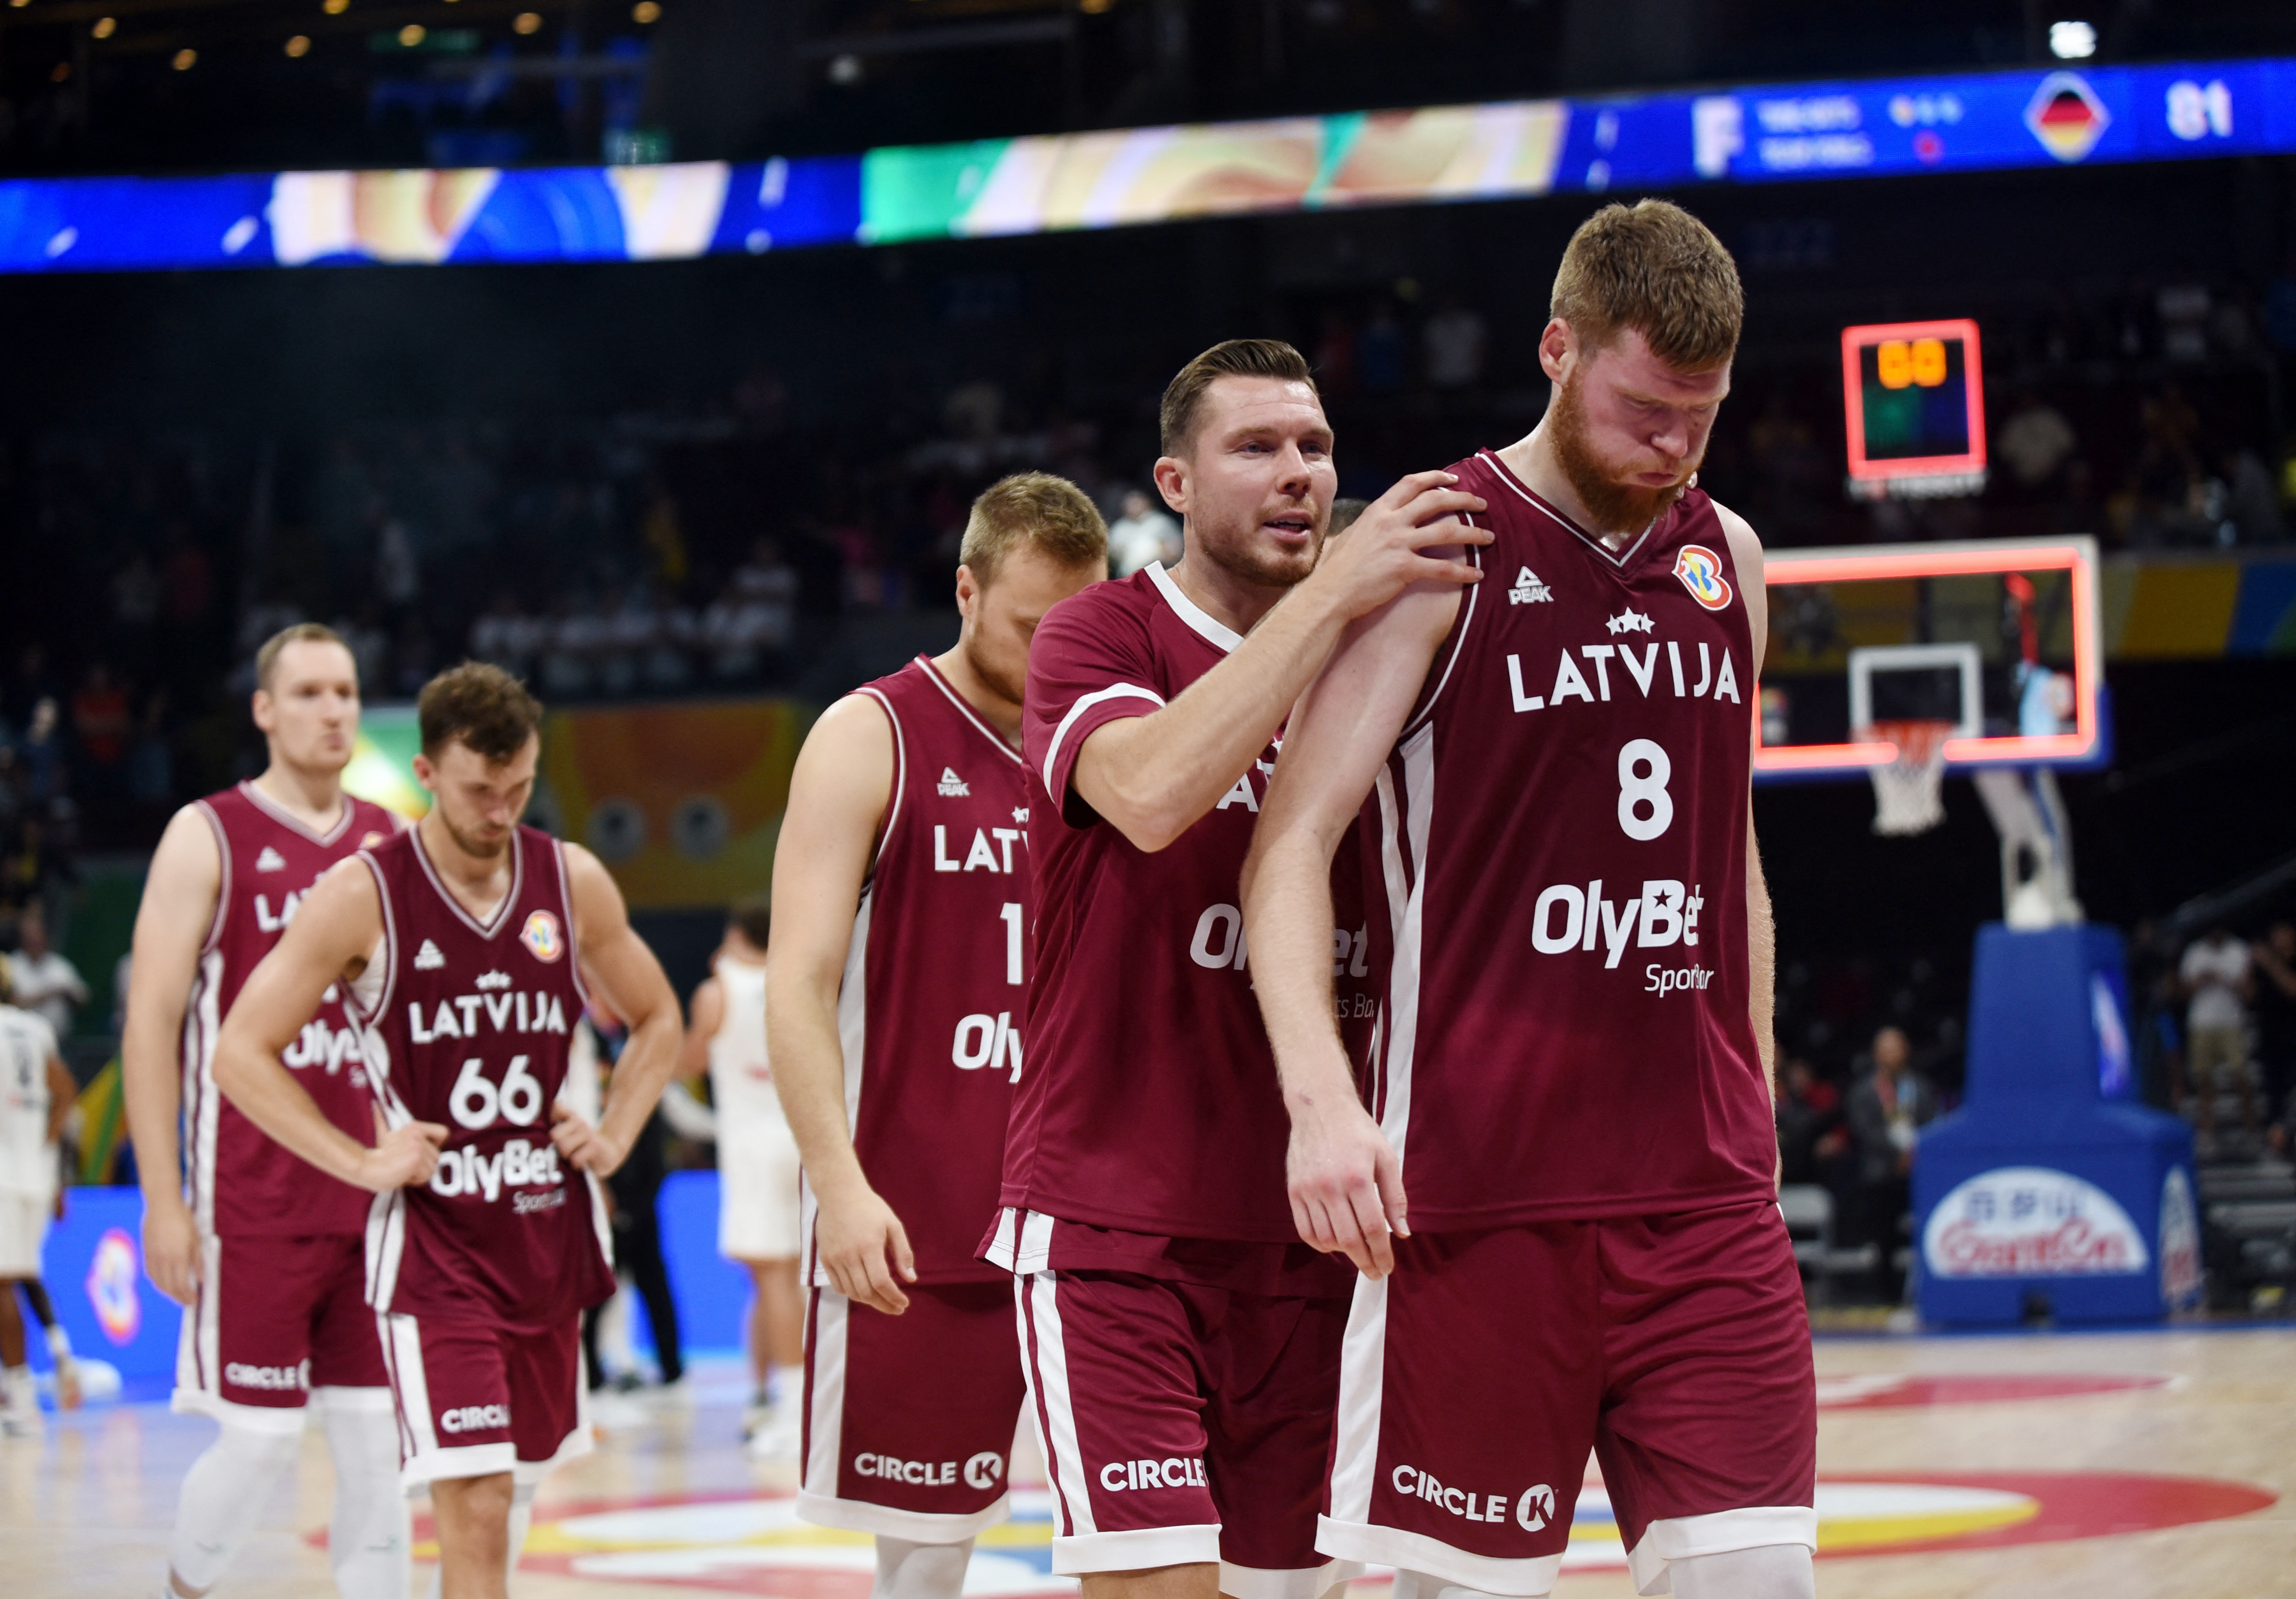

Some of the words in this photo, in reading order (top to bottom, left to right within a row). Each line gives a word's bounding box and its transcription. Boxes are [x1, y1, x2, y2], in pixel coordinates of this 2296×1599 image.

[1508, 586, 1554, 605] PEAK
[1507, 641, 1741, 713] LATVIJA
[937, 782, 970, 797] PEAK
[1618, 738, 1673, 841] 8
[934, 825, 1027, 874] LAT
[254, 890, 312, 933] LA
[1000, 902, 1036, 985] 1
[409, 991, 566, 1044] LATVIJA
[1353, 992, 1374, 1018] Ba
[448, 1055, 542, 1129] 66
[431, 1139, 564, 1203] OlyBet
[224, 1362, 297, 1391] CIRCLE
[855, 1452, 957, 1485] CIRCLE
[1100, 1458, 1206, 1492] CIRCLE
[1392, 1465, 1507, 1523] CIRCLE
